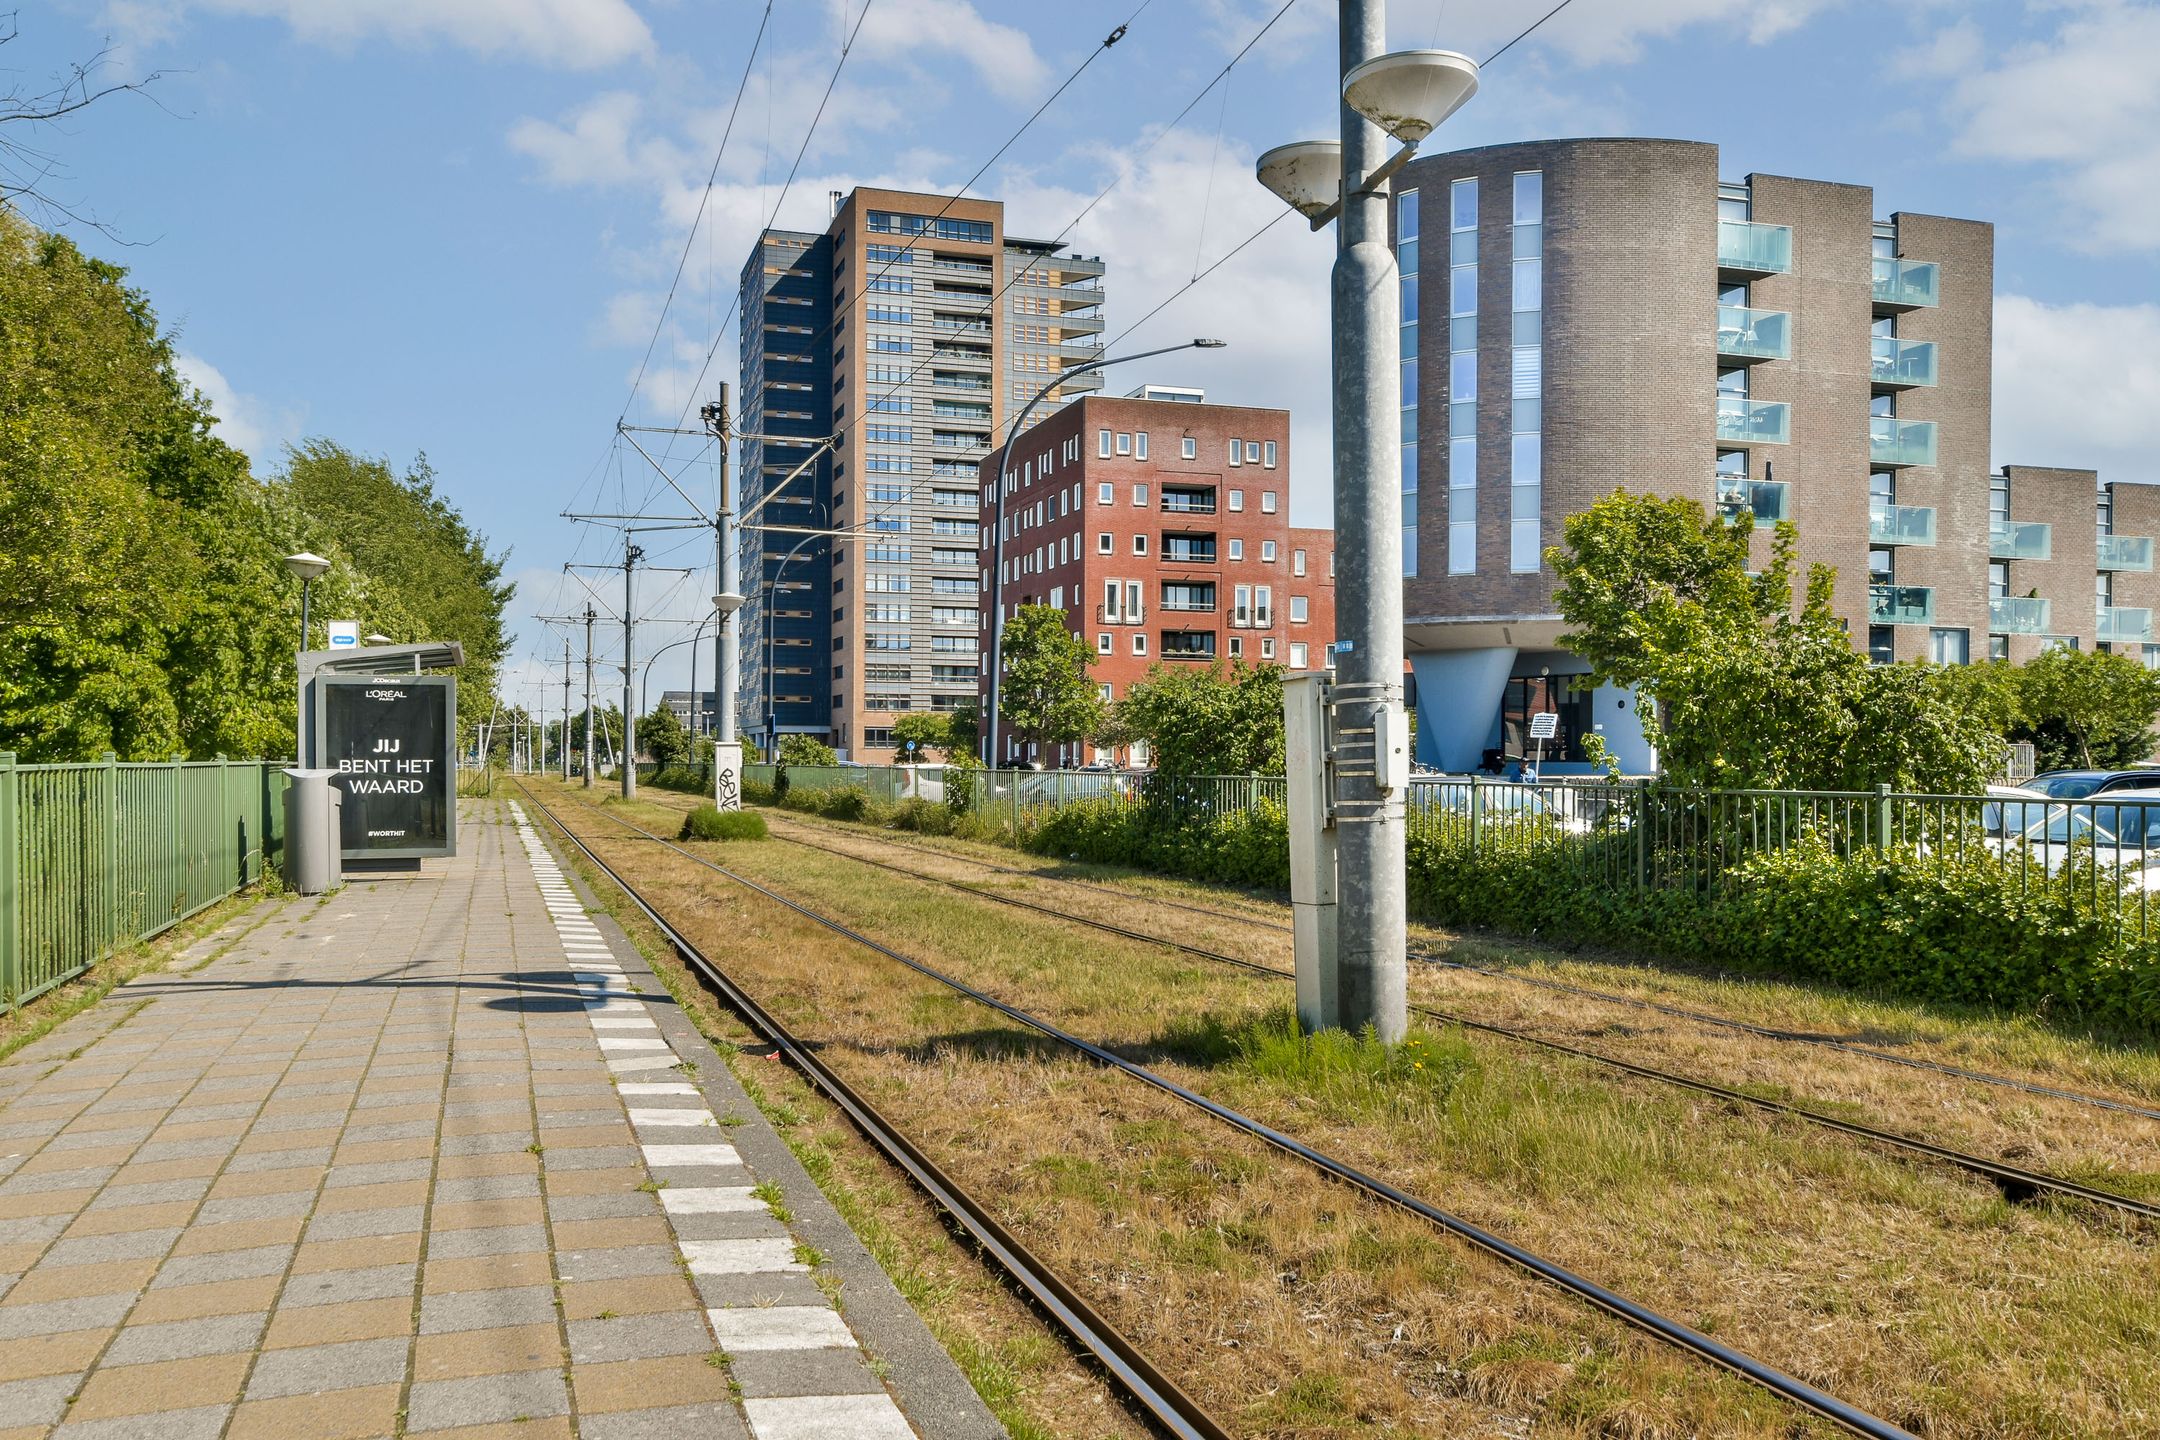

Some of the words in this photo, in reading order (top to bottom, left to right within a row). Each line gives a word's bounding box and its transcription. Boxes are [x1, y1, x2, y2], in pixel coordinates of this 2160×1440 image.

[365, 689, 407, 698] L'ORÉAL
[372, 738, 400, 753] JIJ
[339, 759, 391, 774] BENT
[396, 759, 434, 774] HET
[349, 779, 424, 794] WAARD
